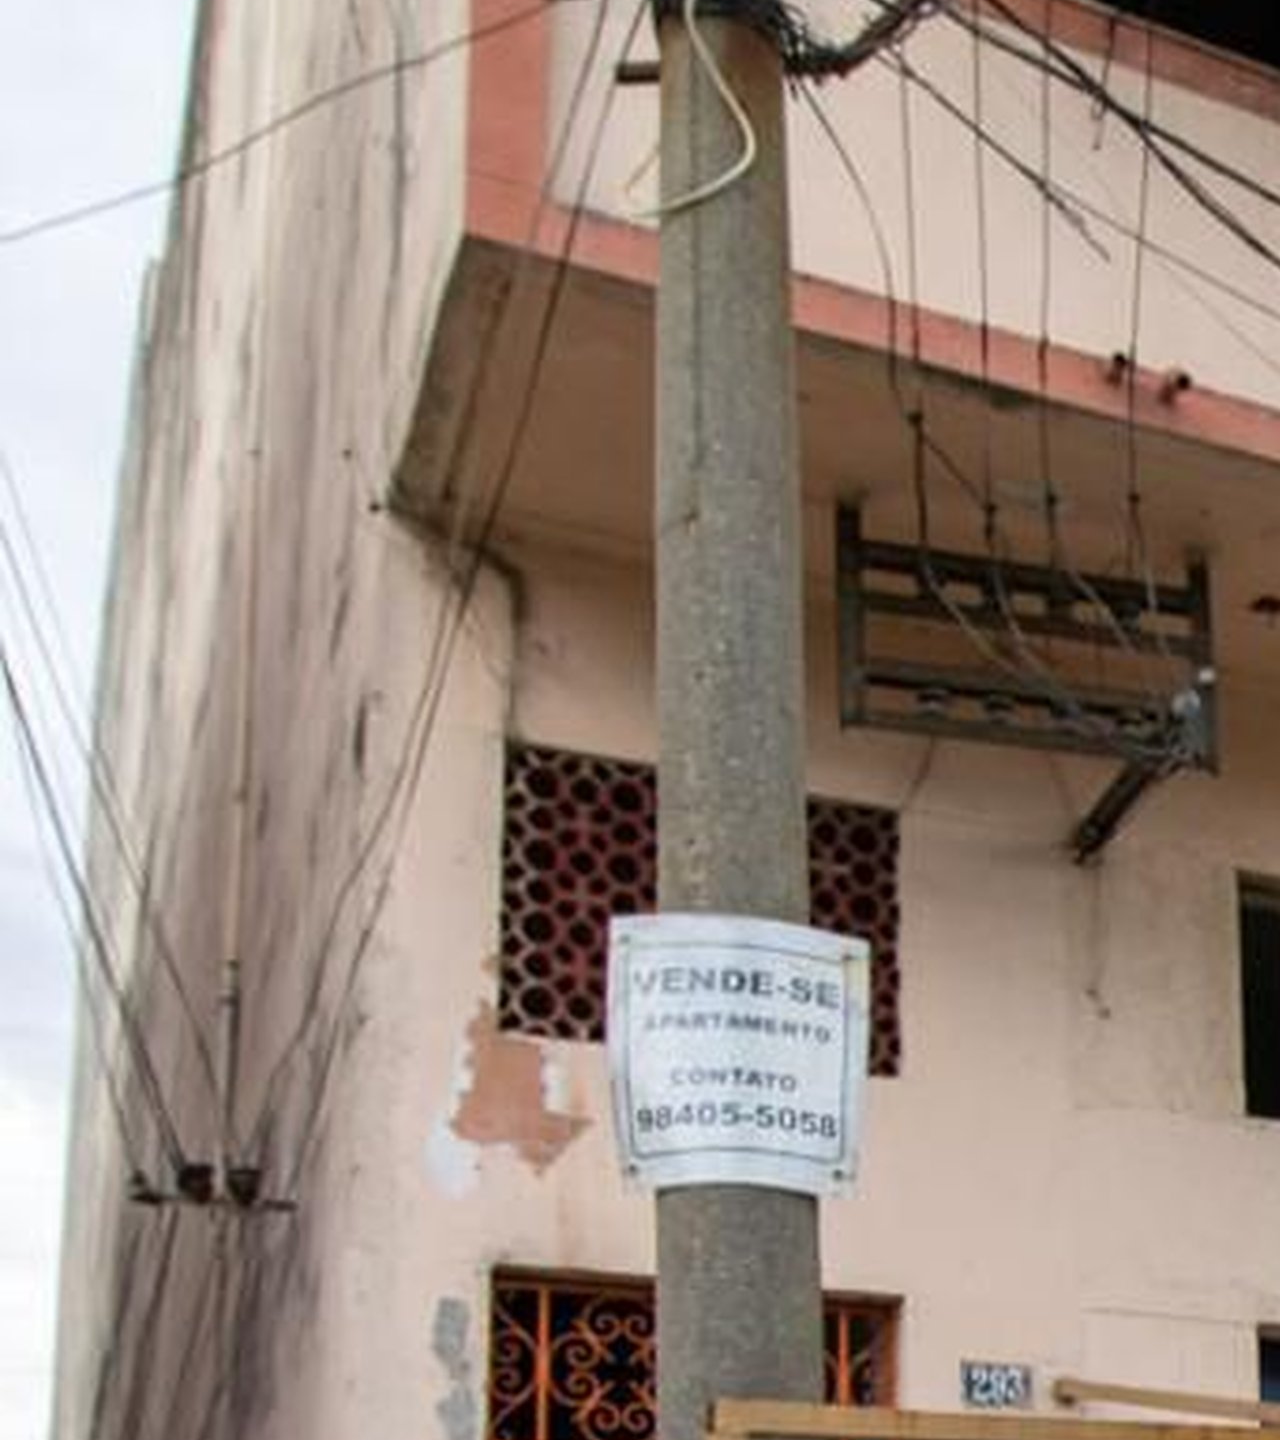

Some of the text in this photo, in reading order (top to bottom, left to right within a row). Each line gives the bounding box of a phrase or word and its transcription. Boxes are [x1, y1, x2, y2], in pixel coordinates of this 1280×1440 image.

[633, 966, 841, 1009] VENDE-SE
[645, 1011, 831, 1044] APARTAMENTO
[669, 1066, 798, 1093] CONTATO
[636, 1101, 838, 1138] 98405-5058
